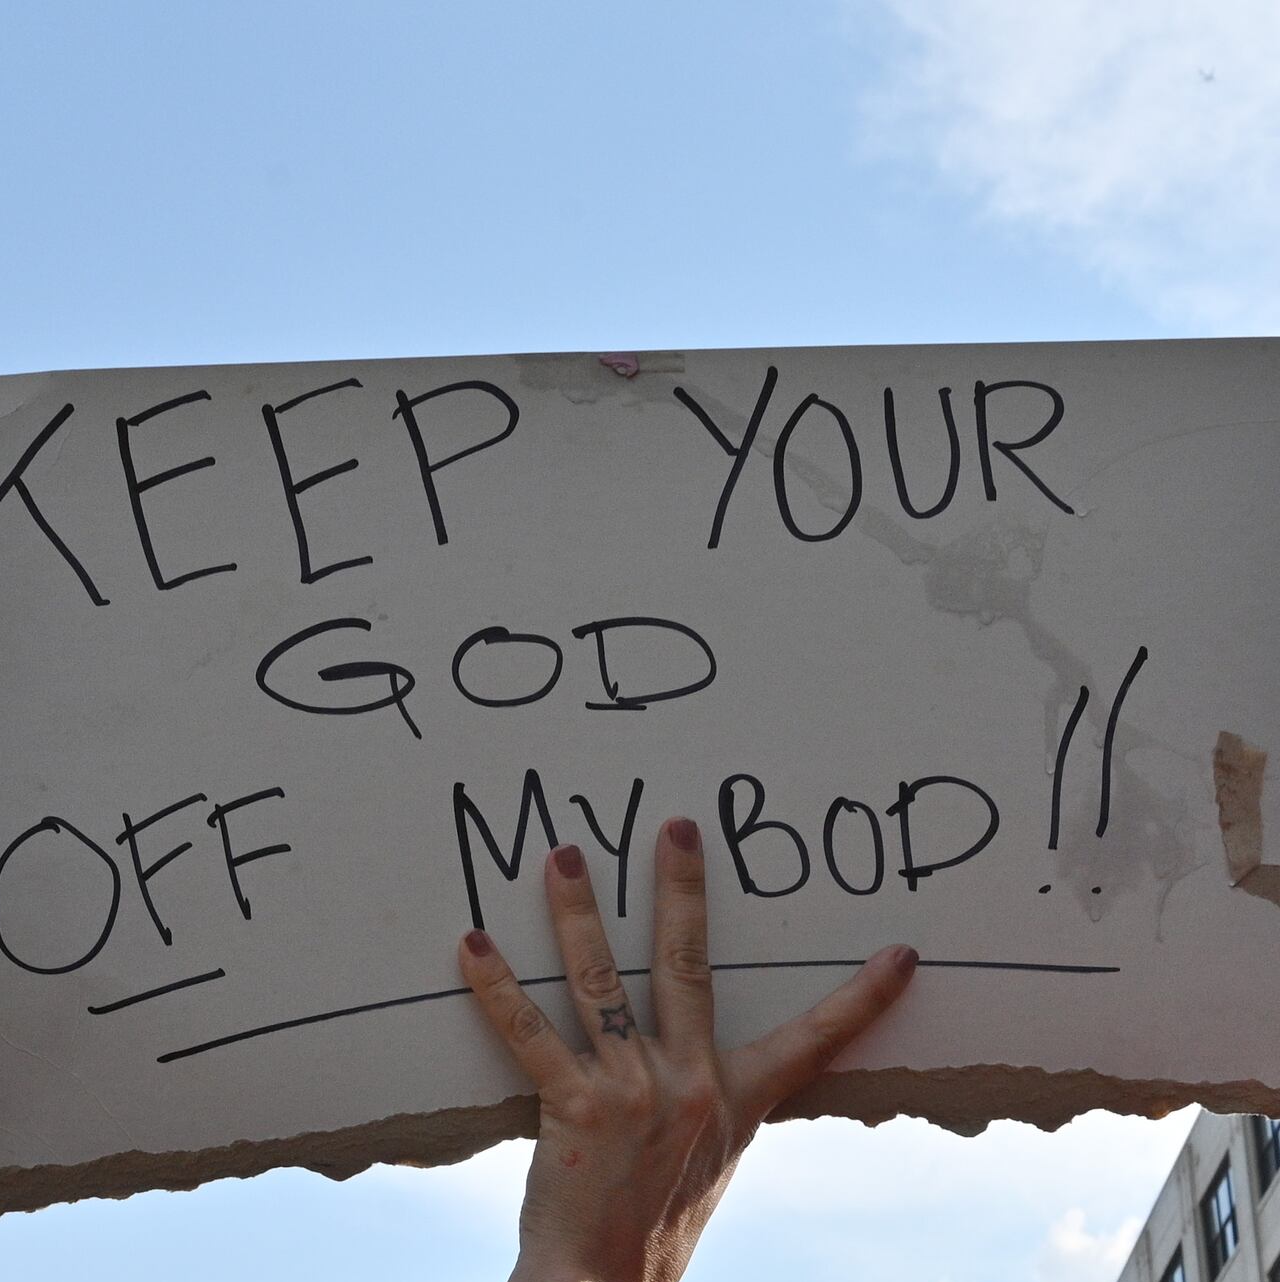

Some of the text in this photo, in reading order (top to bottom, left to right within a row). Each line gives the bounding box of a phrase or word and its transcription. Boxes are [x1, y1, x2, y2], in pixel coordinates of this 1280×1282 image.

[673, 366, 1075, 550] YOUR
[256, 616, 717, 740] GOD
[452, 768, 645, 932] MY
